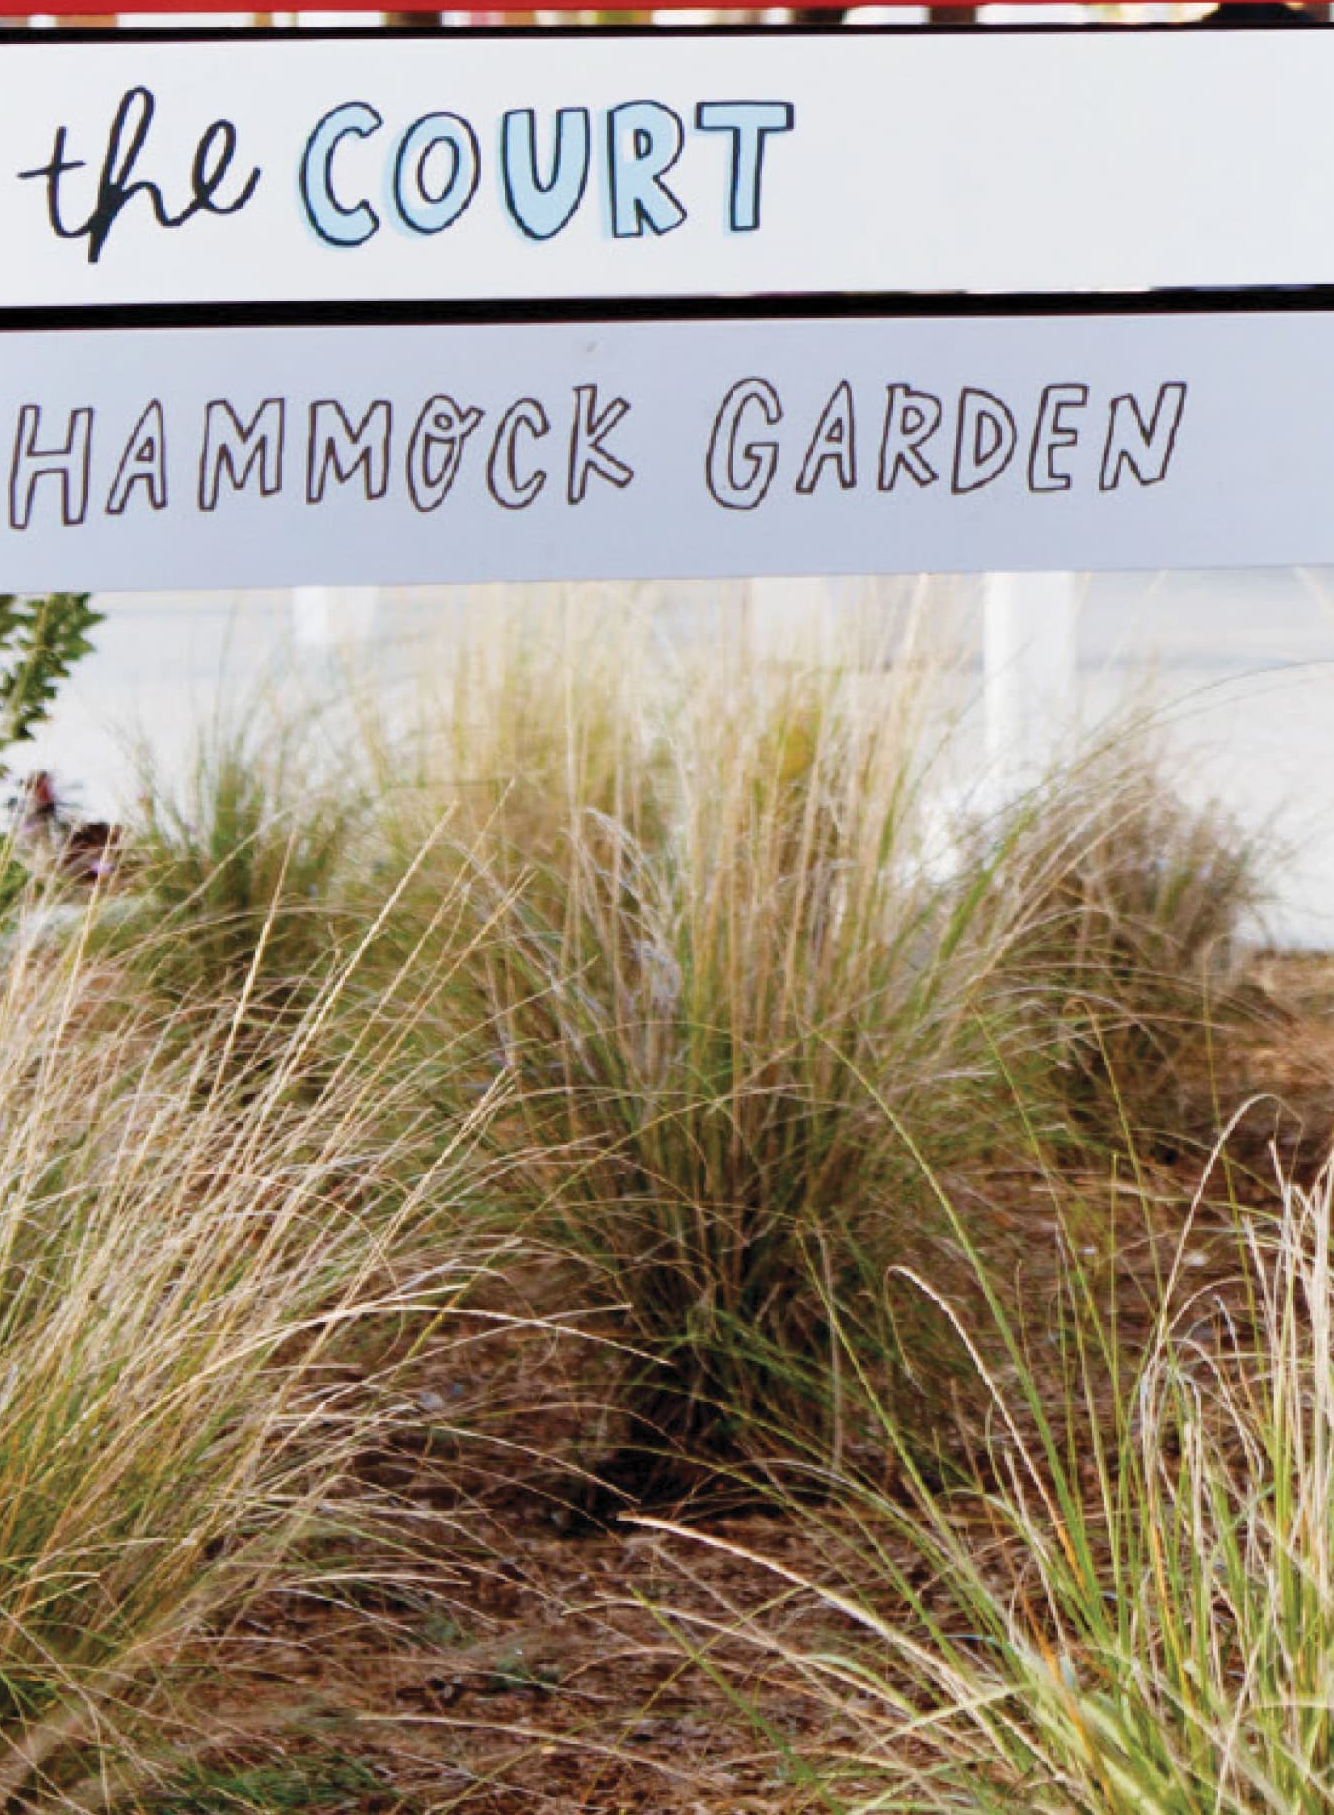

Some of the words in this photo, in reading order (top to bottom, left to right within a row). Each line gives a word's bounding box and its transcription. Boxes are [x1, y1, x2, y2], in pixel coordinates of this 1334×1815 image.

[17, 85, 261, 264] the
[299, 100, 794, 248] COURT
[10, 384, 634, 529] HAMMOCK
[706, 377, 1187, 510] GARDEN
